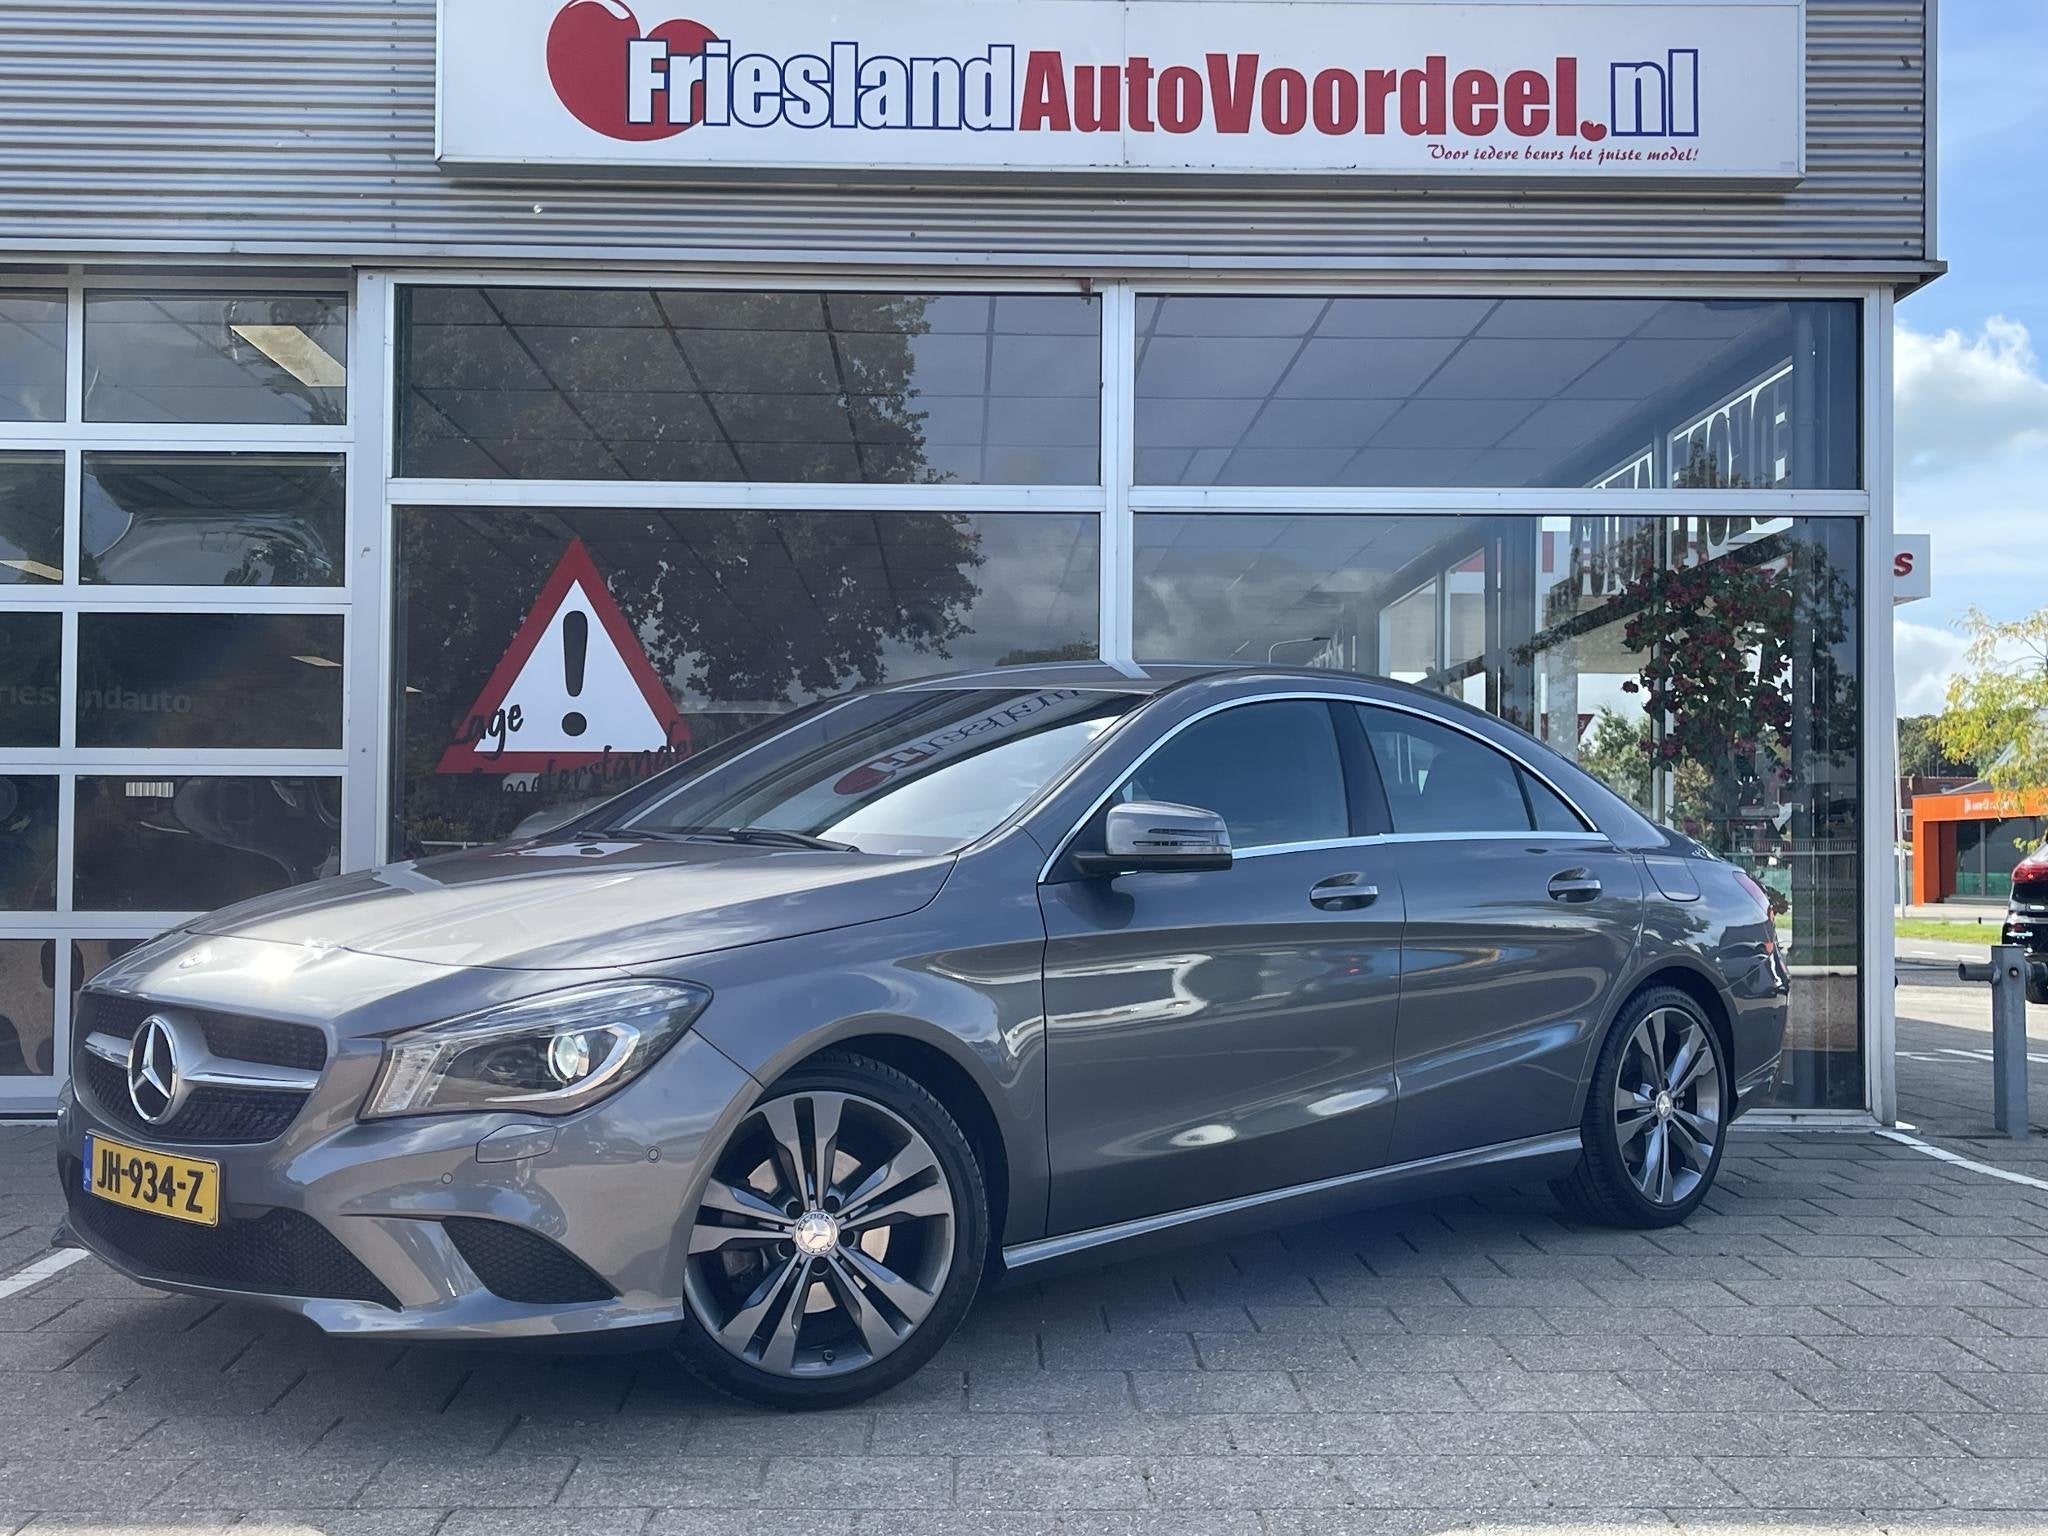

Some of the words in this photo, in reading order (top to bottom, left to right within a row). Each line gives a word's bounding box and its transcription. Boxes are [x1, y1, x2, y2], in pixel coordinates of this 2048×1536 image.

[627, 38, 1699, 141] FrieslandAutoVoordeel.nl
[1427, 144, 1470, 160] Voor
[1473, 145, 1519, 160] iedere
[1524, 145, 1564, 160] beurs
[1569, 145, 1593, 160] het
[1598, 147, 1643, 166] juiste
[1647, 145, 1699, 161] model!
[97, 1149, 204, 1214] JH-934-Z
